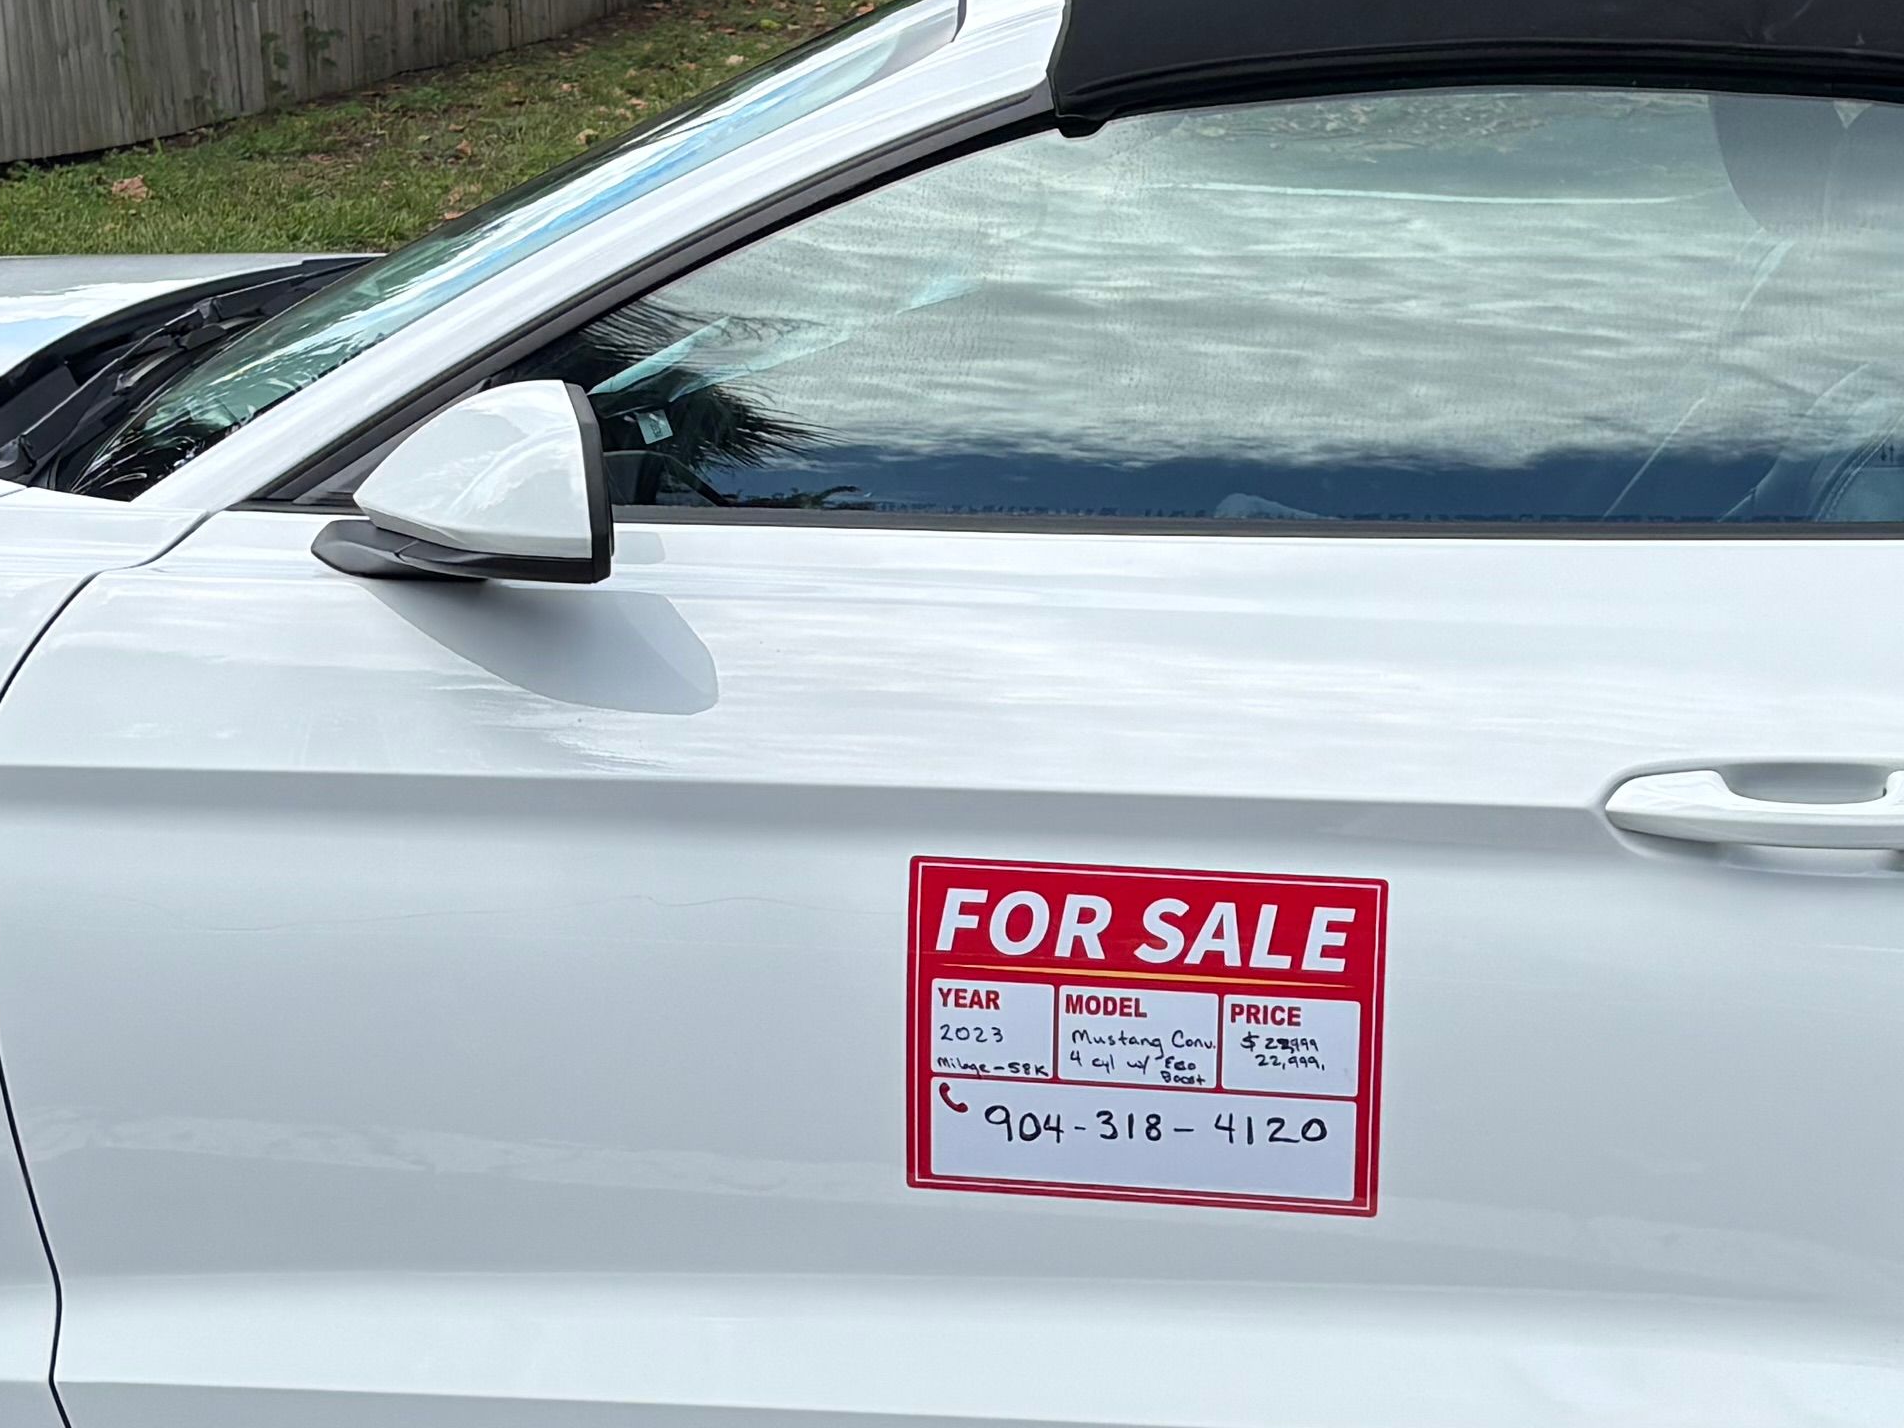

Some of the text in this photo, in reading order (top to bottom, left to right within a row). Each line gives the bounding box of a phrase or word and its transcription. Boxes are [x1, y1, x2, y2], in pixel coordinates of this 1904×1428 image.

[935, 887, 1357, 972] FOR SALE
[938, 987, 1000, 1010] YEAR
[1065, 994, 1147, 1018] MODEL
[1231, 1003, 1301, 1027] PRICE
[940, 1024, 1003, 1043] 2023
[1072, 1029, 1216, 1060] Mustang Conv.
[1070, 1050, 1082, 1067] 4
[1092, 1054, 1115, 1074] cyl
